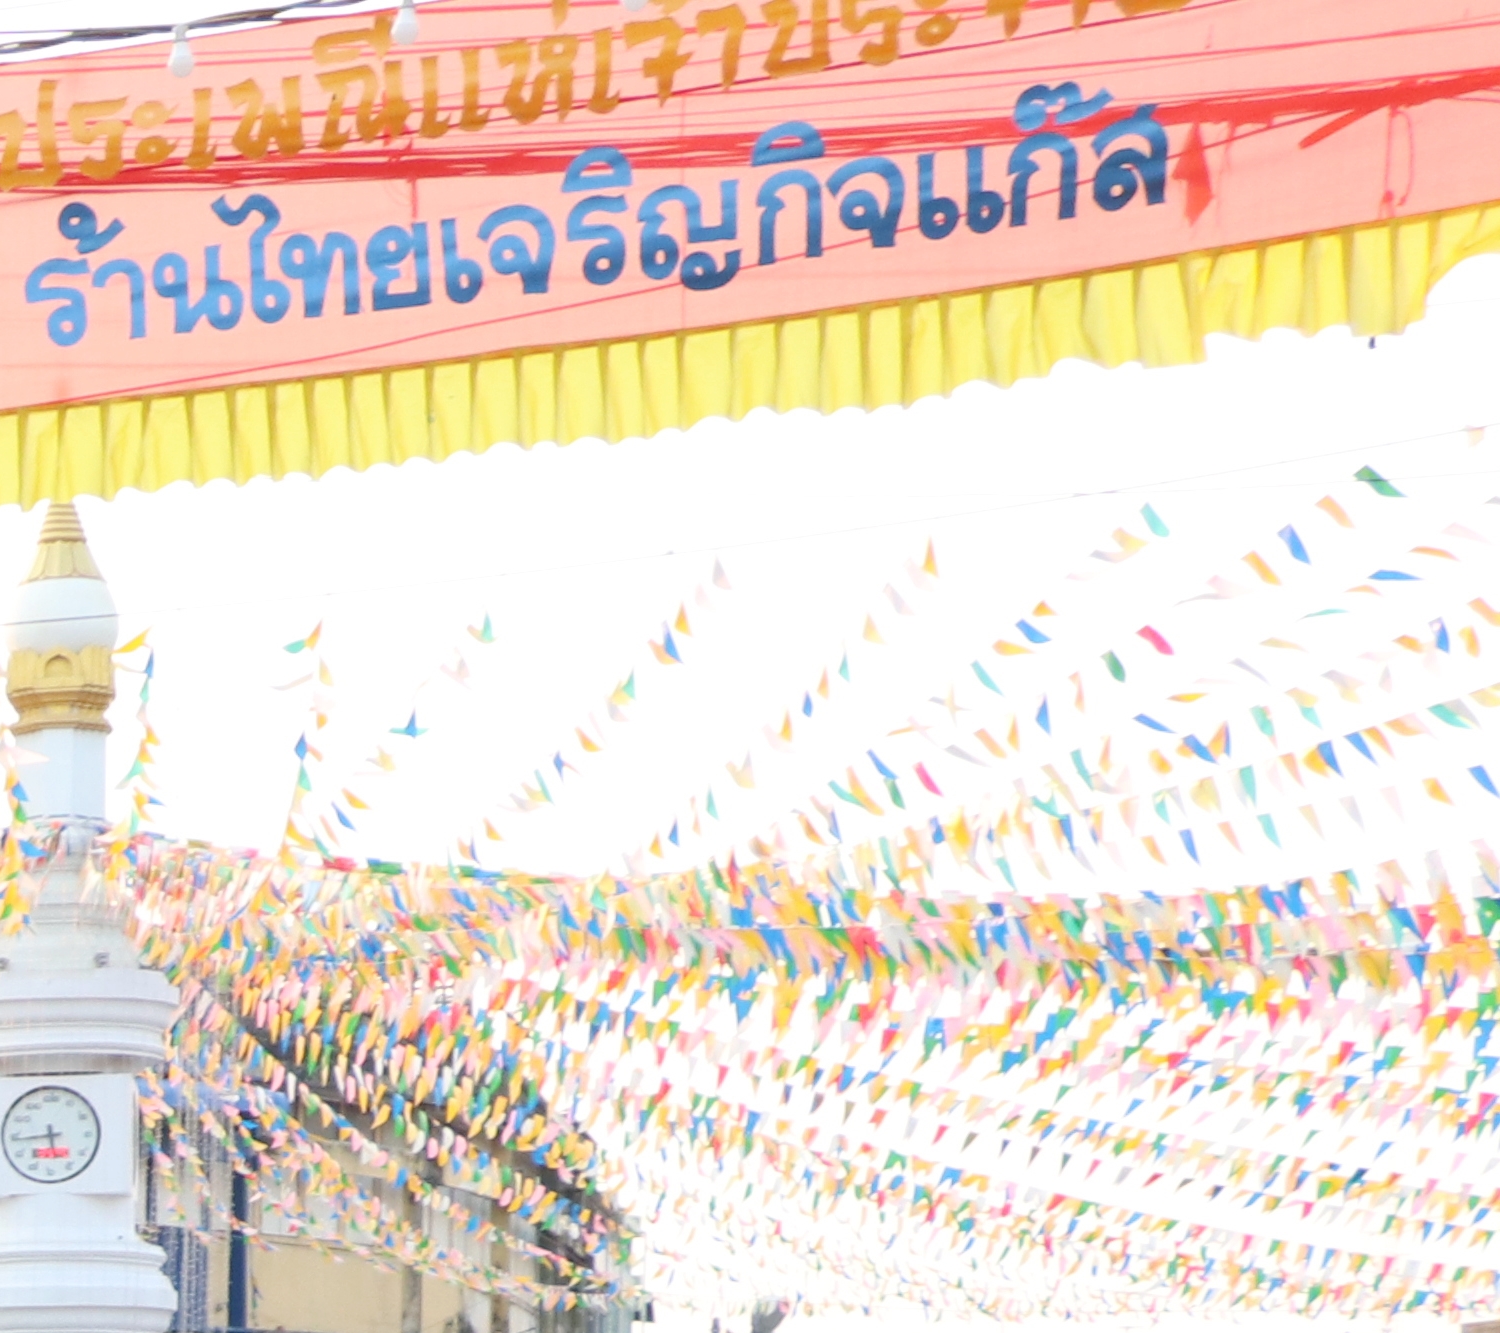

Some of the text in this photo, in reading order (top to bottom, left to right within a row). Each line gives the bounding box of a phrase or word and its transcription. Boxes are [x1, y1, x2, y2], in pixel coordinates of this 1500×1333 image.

[23, 81, 1169, 346] ร้านไทยเจริญกิจแก๊ส
